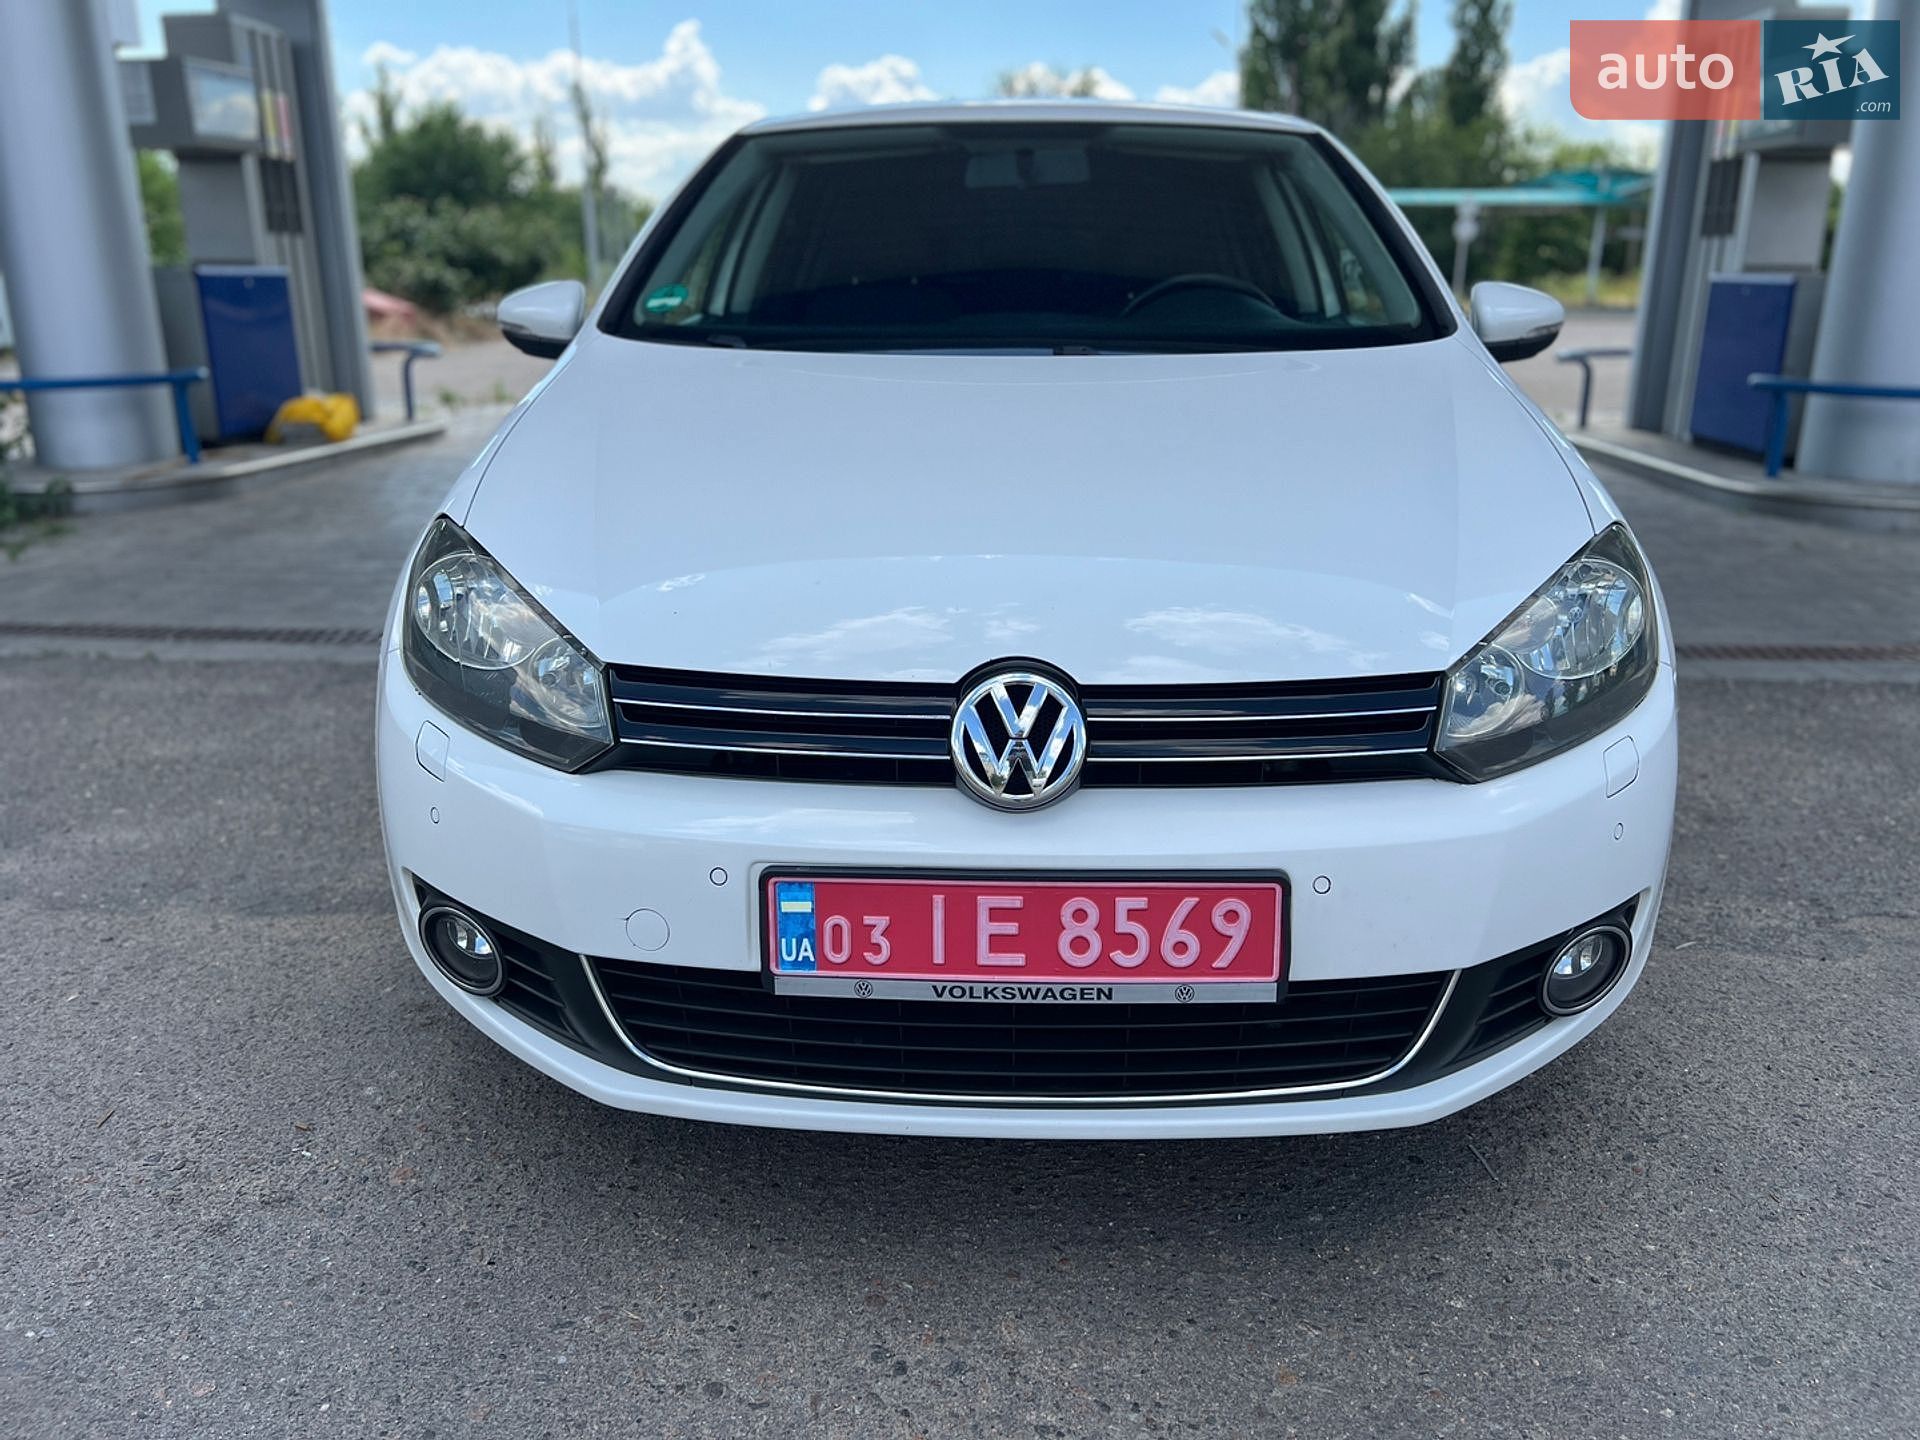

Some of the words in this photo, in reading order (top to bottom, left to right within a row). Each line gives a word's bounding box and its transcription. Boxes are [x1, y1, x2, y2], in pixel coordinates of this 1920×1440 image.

[823, 914, 891, 965] 03
[932, 894, 1026, 967] IE
[1057, 896, 1252, 969] 8569
[781, 938, 815, 962] UA
[931, 984, 1113, 1002] VOLKSWAGEN
